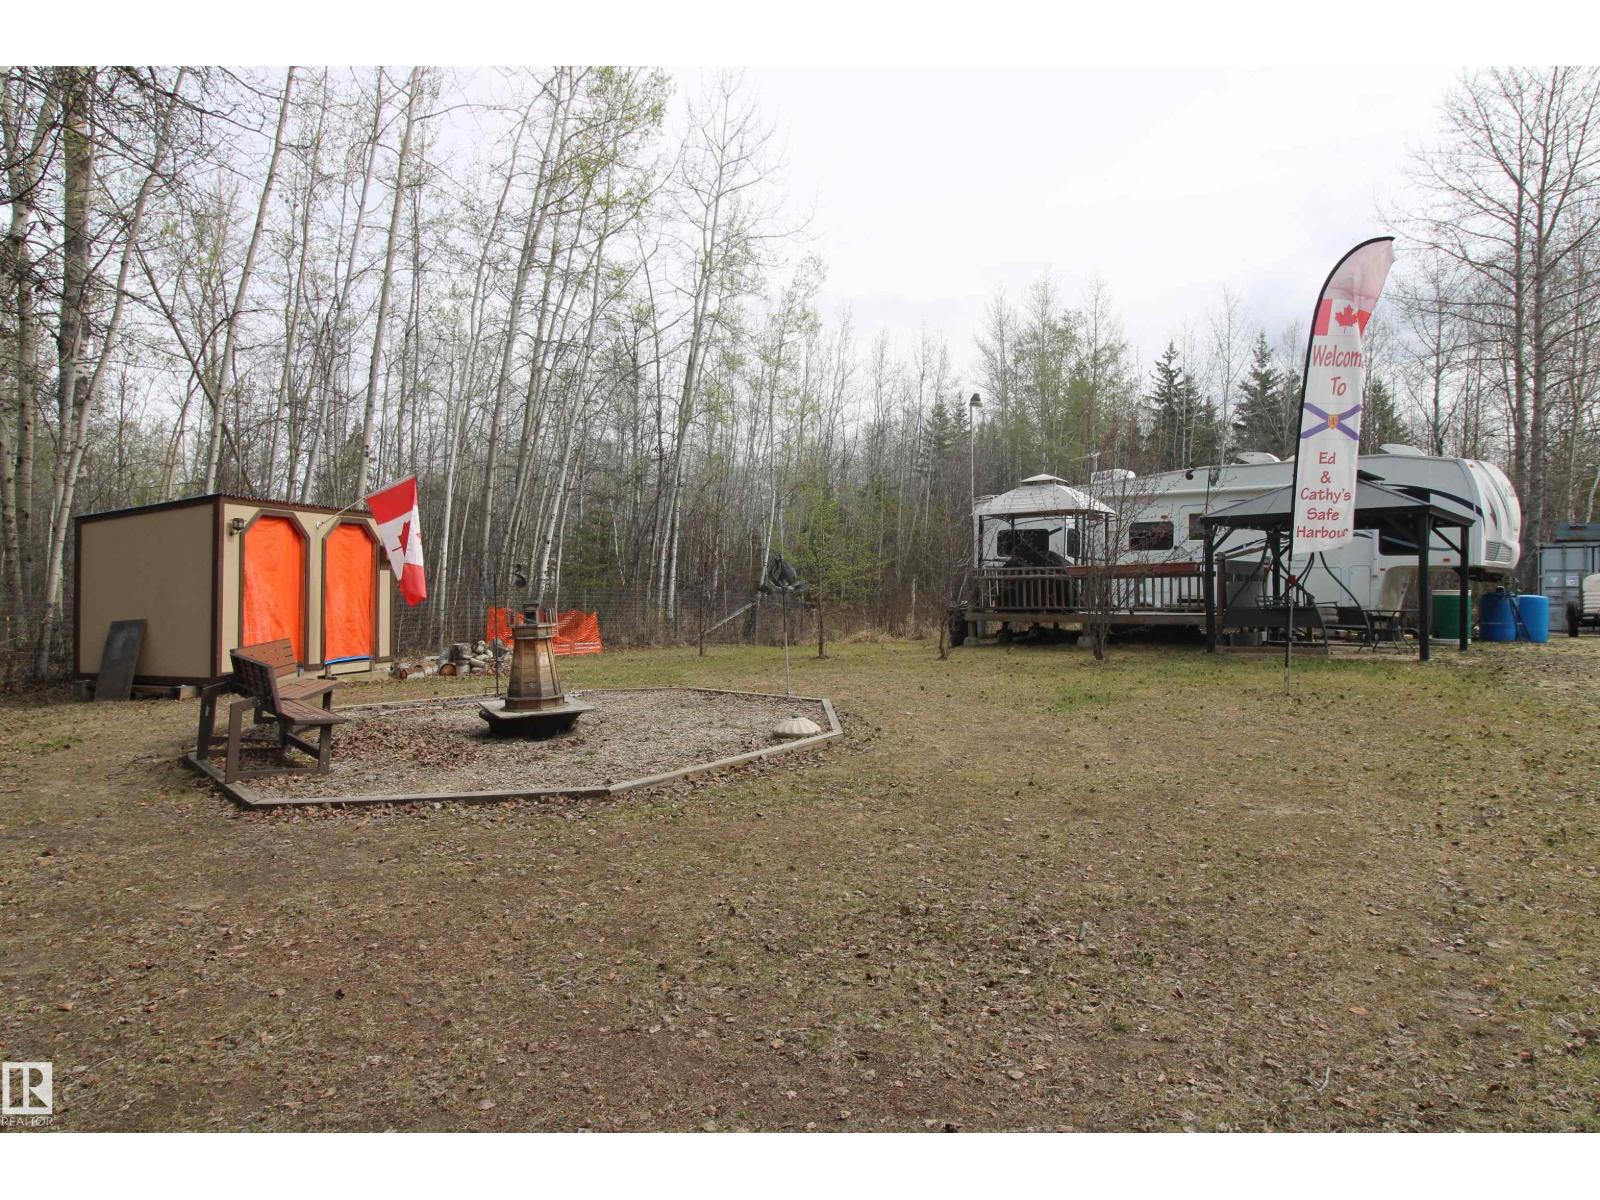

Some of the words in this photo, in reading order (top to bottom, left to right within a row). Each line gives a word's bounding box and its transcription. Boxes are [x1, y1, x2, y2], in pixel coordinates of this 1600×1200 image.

[1313, 344, 1363, 368] Welcom
[1330, 376, 1347, 396] To
[1319, 452, 1336, 465] Ed
[1320, 471, 1331, 484] &
[1300, 487, 1351, 504] Cathy's
[1307, 507, 1340, 521] Safe
[1296, 525, 1349, 539] Harbour
